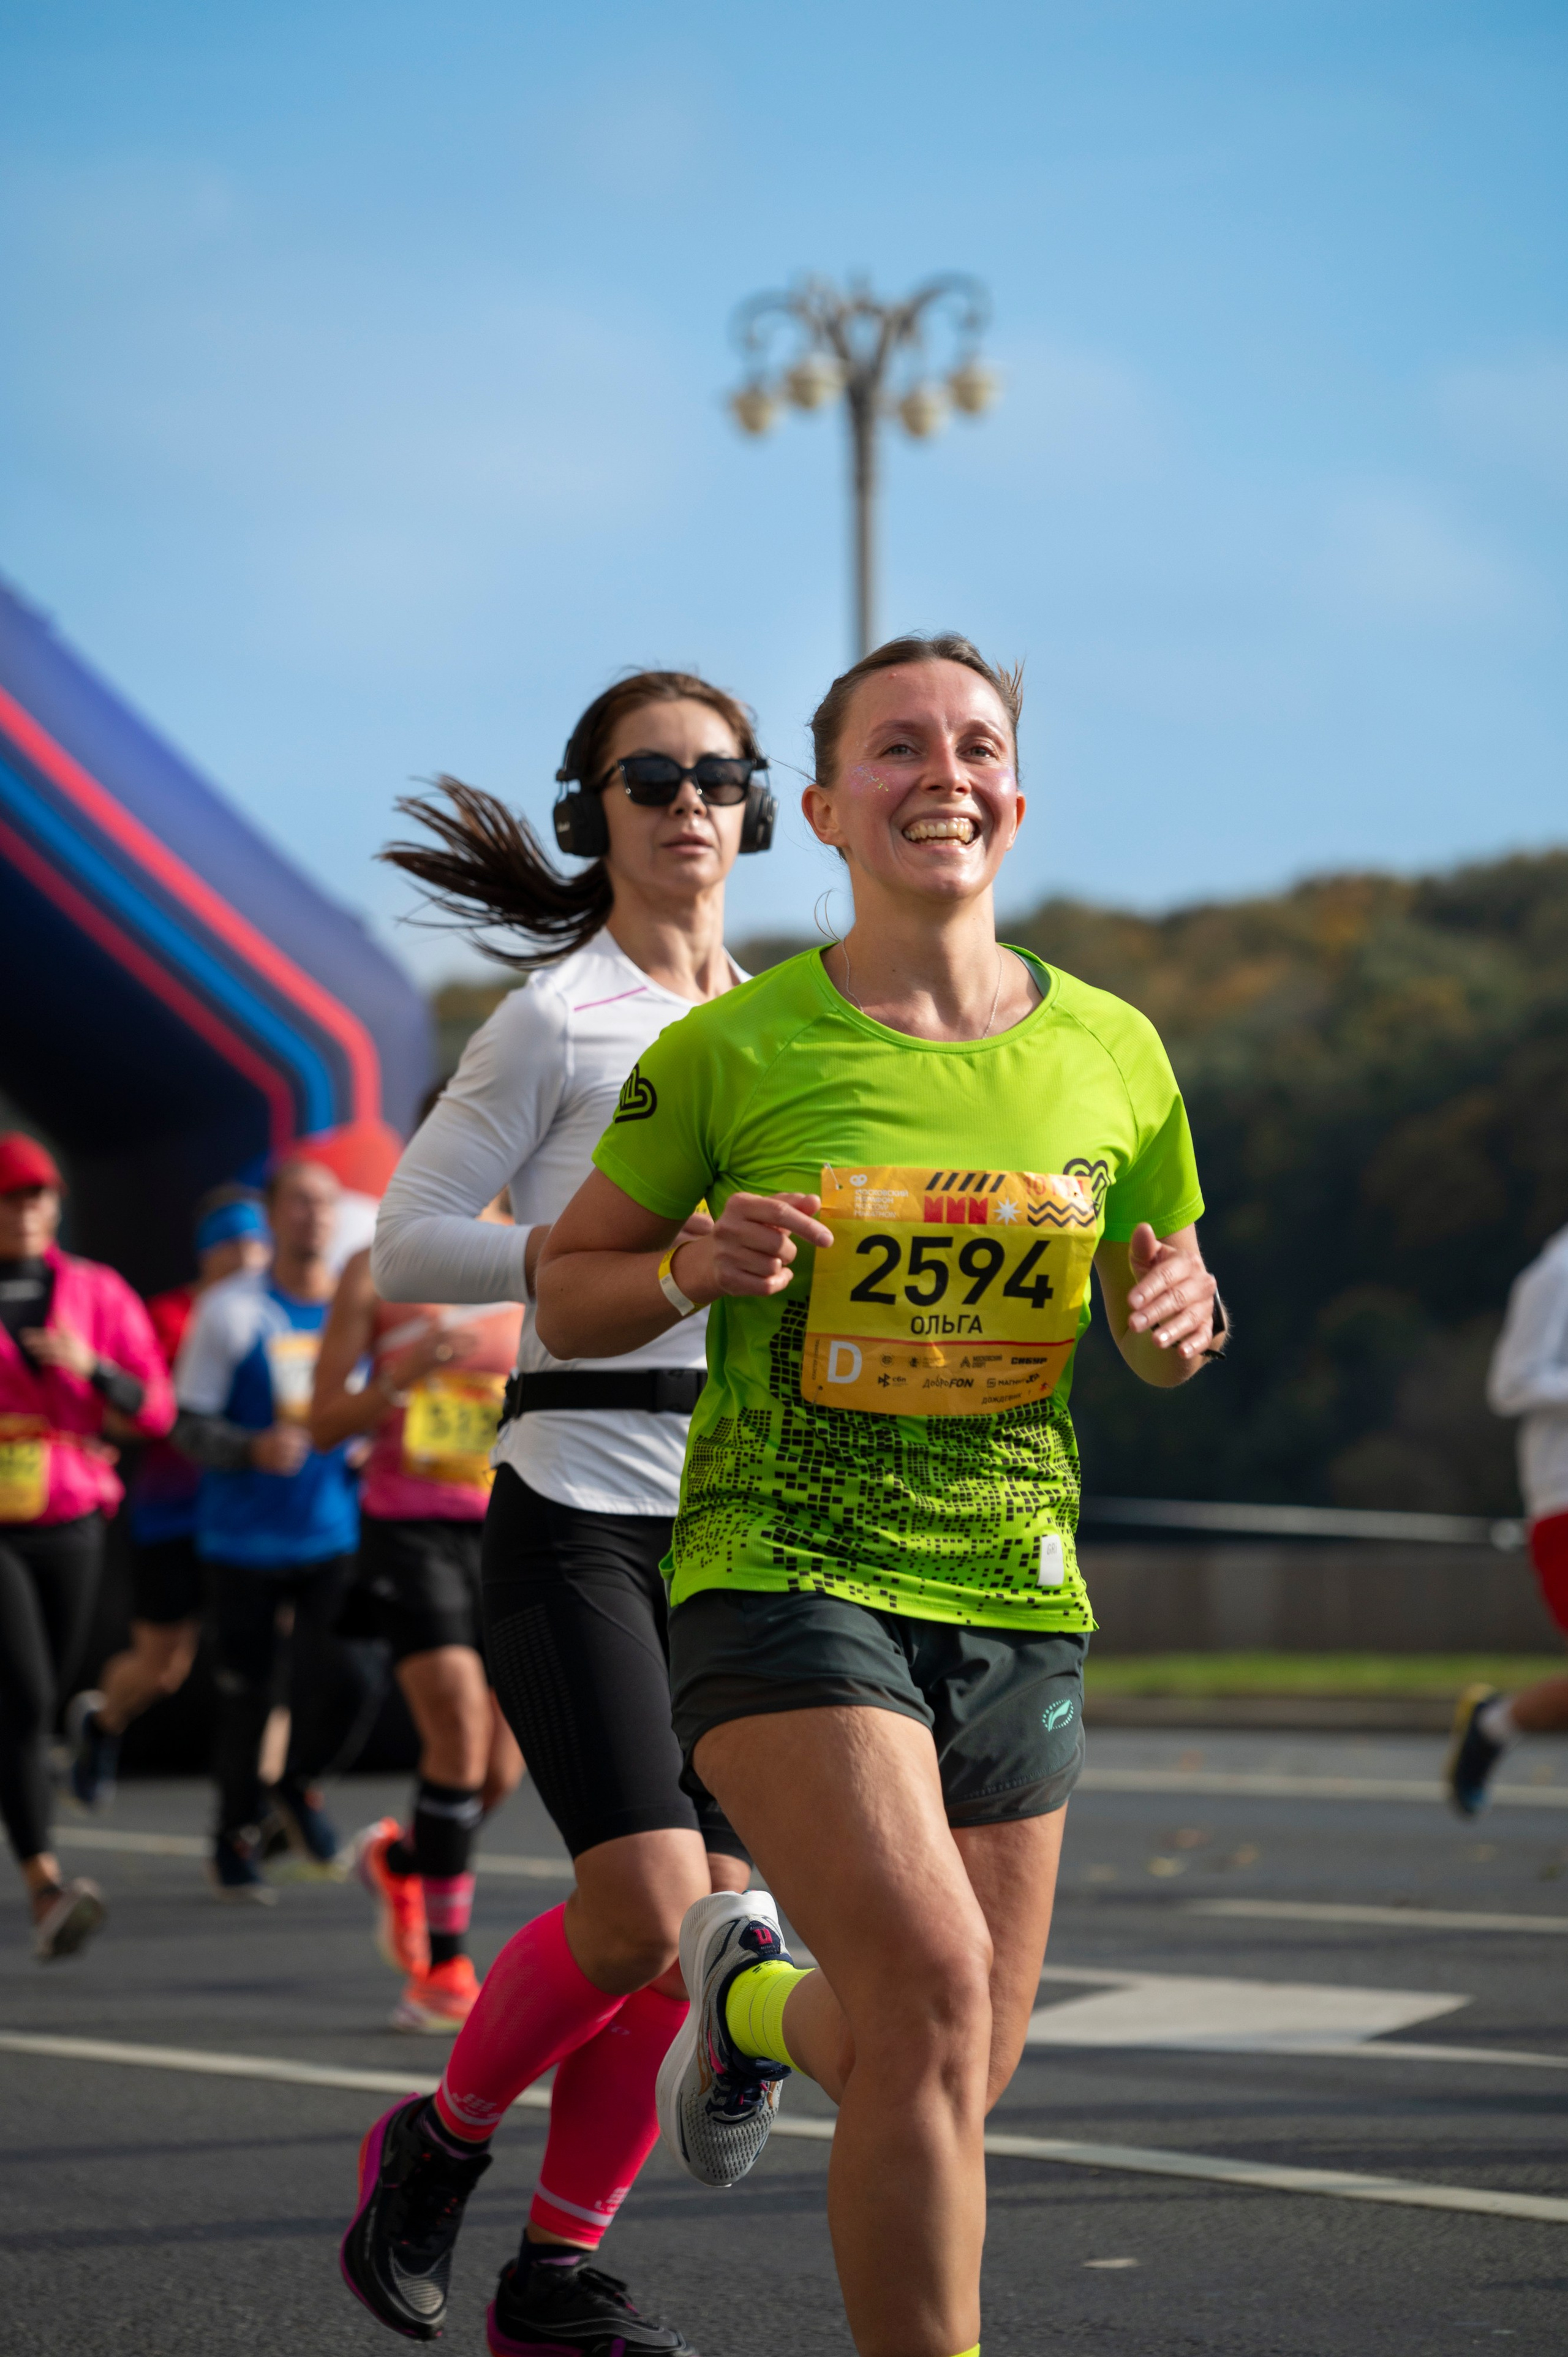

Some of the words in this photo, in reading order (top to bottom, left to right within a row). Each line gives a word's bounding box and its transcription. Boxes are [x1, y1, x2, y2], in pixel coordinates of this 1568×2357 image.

[850, 1234, 1054, 1308] 2594
[911, 1315, 982, 1335] ОЛЬГА
[827, 1340, 862, 1384] D
